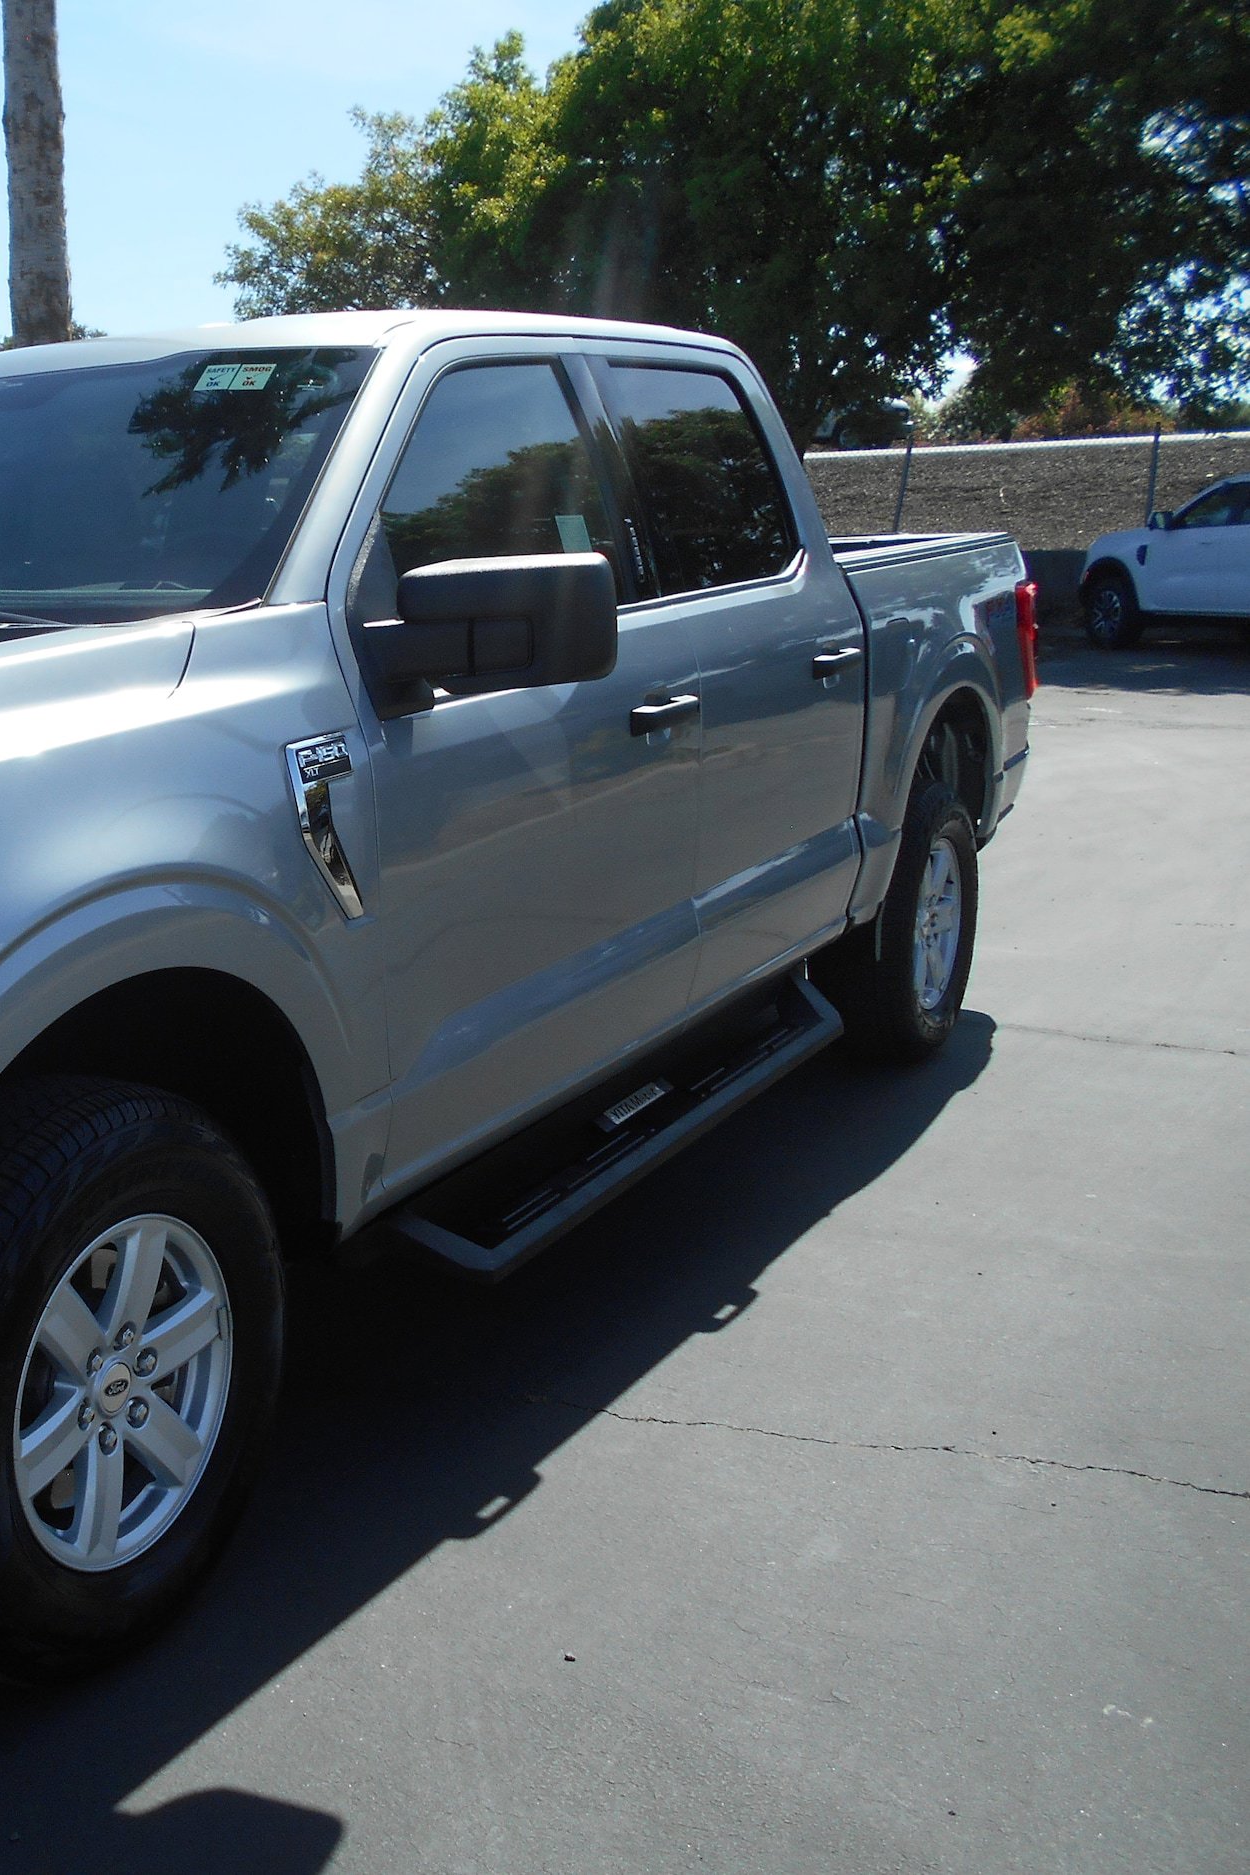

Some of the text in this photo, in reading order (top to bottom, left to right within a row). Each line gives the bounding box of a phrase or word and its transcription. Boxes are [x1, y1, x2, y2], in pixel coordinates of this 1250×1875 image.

[297, 741, 349, 768] F-150
[304, 767, 320, 778] XLT
[107, 1380, 127, 1396] Ford
